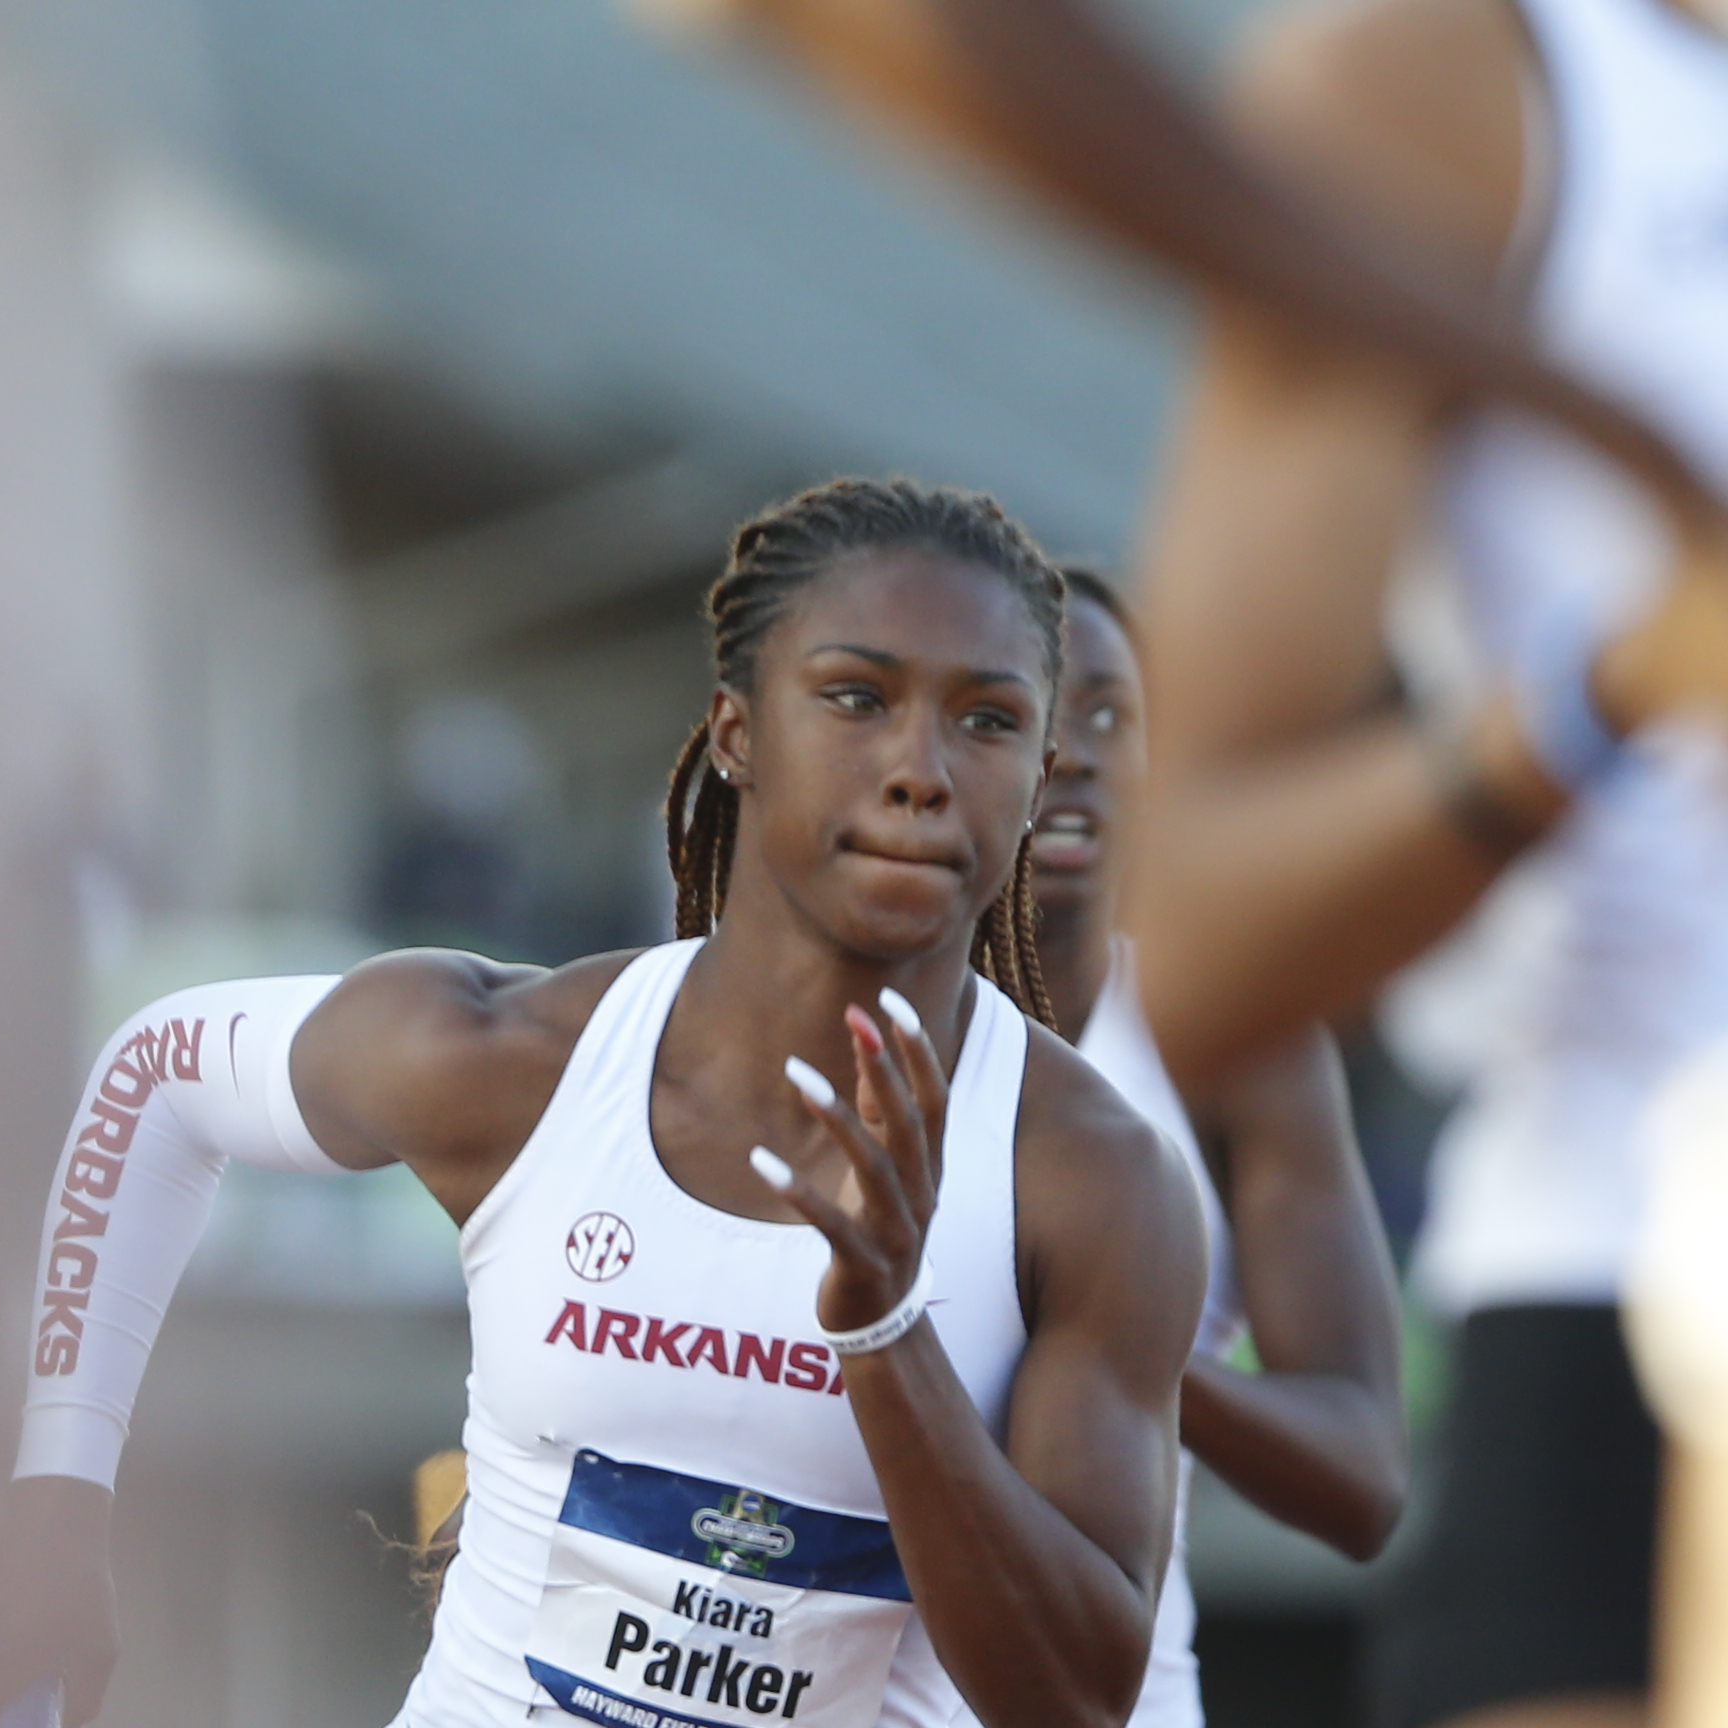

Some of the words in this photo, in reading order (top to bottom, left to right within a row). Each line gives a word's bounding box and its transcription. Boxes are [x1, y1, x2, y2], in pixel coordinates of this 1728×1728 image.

[34, 1016, 207, 1379] RAZORBACKS
[565, 1210, 636, 1283] SEC
[672, 1579, 775, 1639] Kiara
[604, 1609, 815, 1720] Parker
